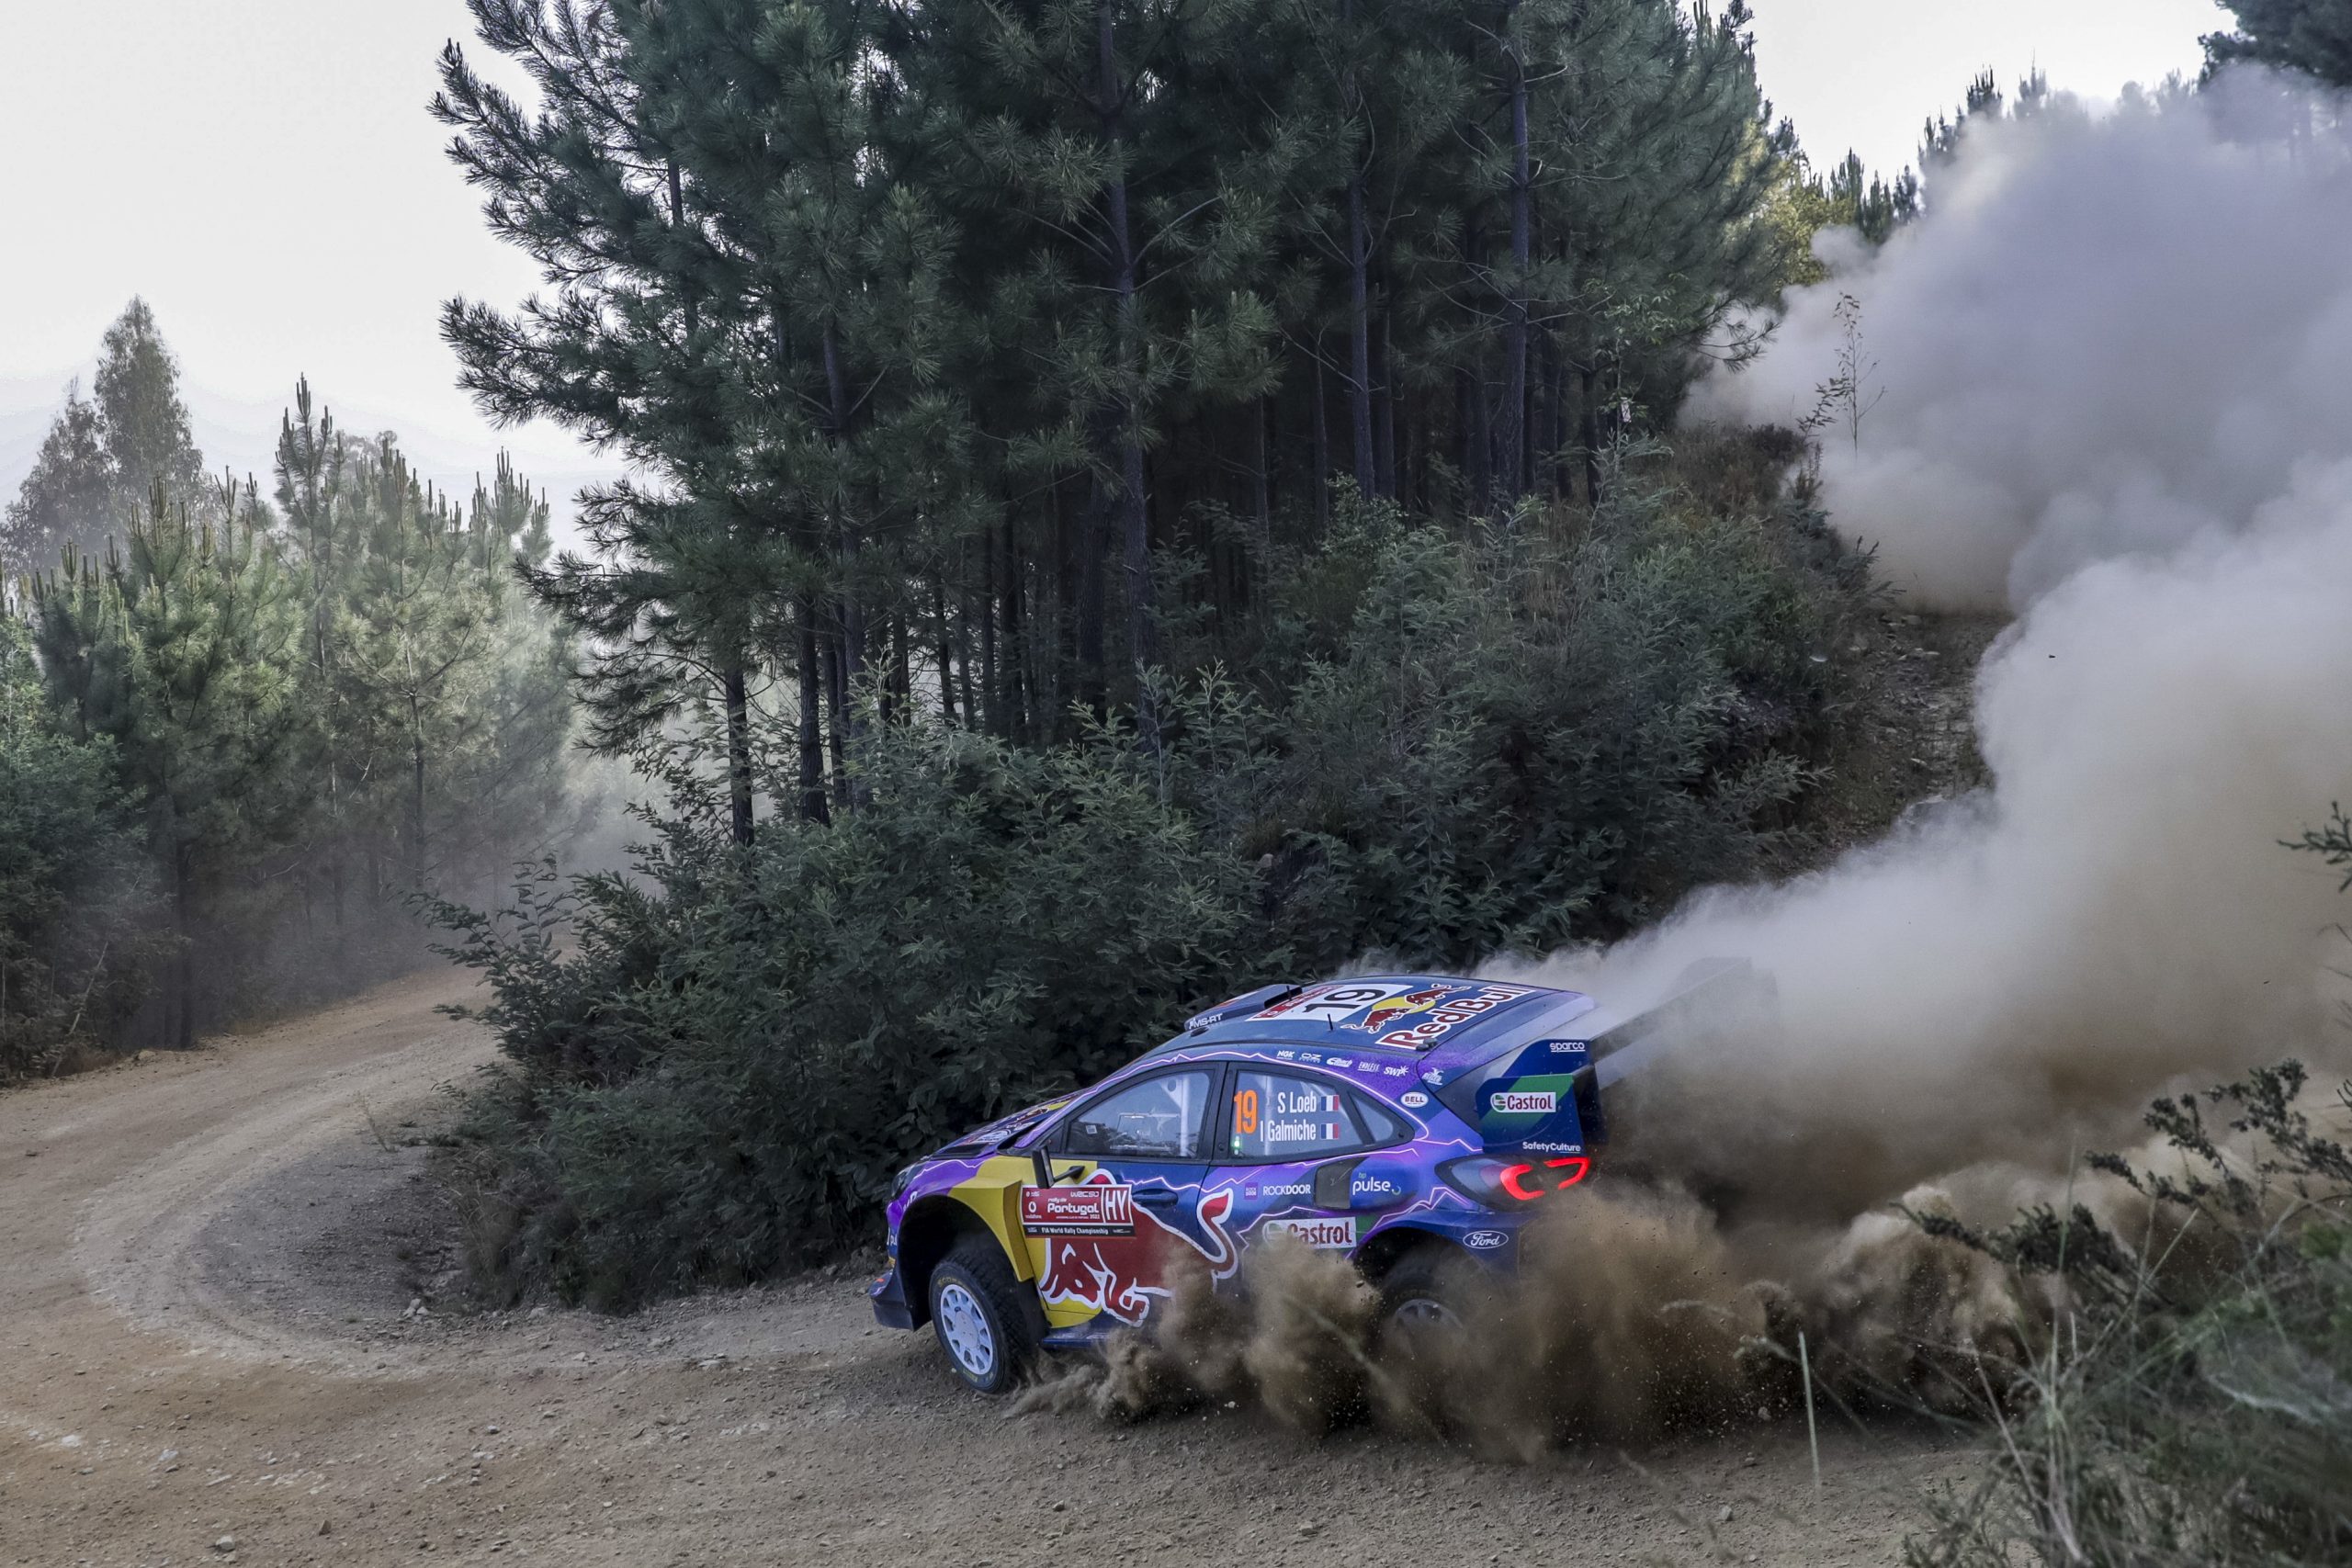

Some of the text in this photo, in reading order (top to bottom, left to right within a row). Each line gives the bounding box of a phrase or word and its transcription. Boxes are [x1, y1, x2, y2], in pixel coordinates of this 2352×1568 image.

[1277, 1050, 1295, 1058] NGK
[1549, 1042, 1585, 1052] sparco
[1277, 1090, 1317, 1113] S Loeb
[1507, 1095, 1553, 1110] Castrol
[1234, 1089, 1258, 1134] 19
[1268, 1119, 1317, 1142] Galmiche
[1522, 1142, 1581, 1152] SafetyCulture
[1352, 1176, 1391, 1196] pulse
[1047, 1202, 1100, 1215] Portugal
[1105, 1190, 1128, 1221] HY
[1470, 1233, 1500, 1247] Ford
